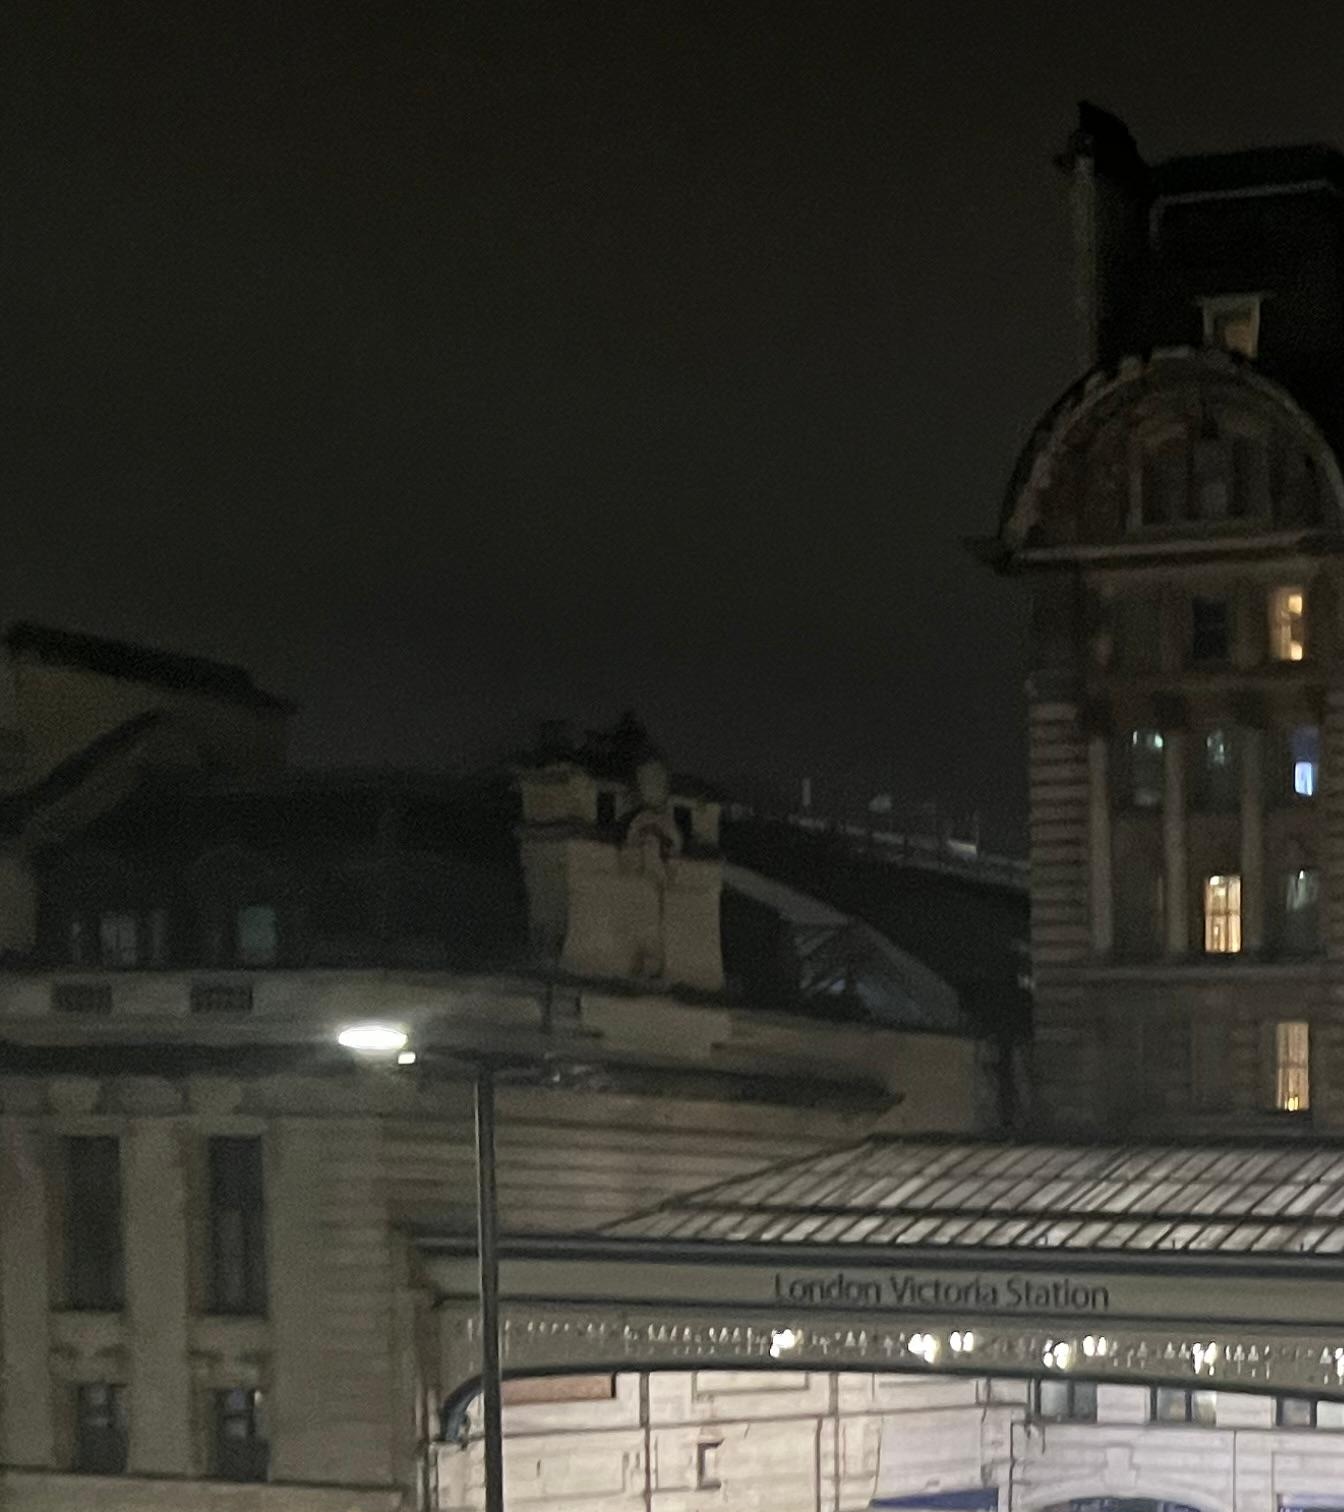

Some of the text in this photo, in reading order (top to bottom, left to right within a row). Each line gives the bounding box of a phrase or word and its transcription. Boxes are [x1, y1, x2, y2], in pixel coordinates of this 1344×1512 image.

[774, 1273, 1110, 1310] London Victoria Station
